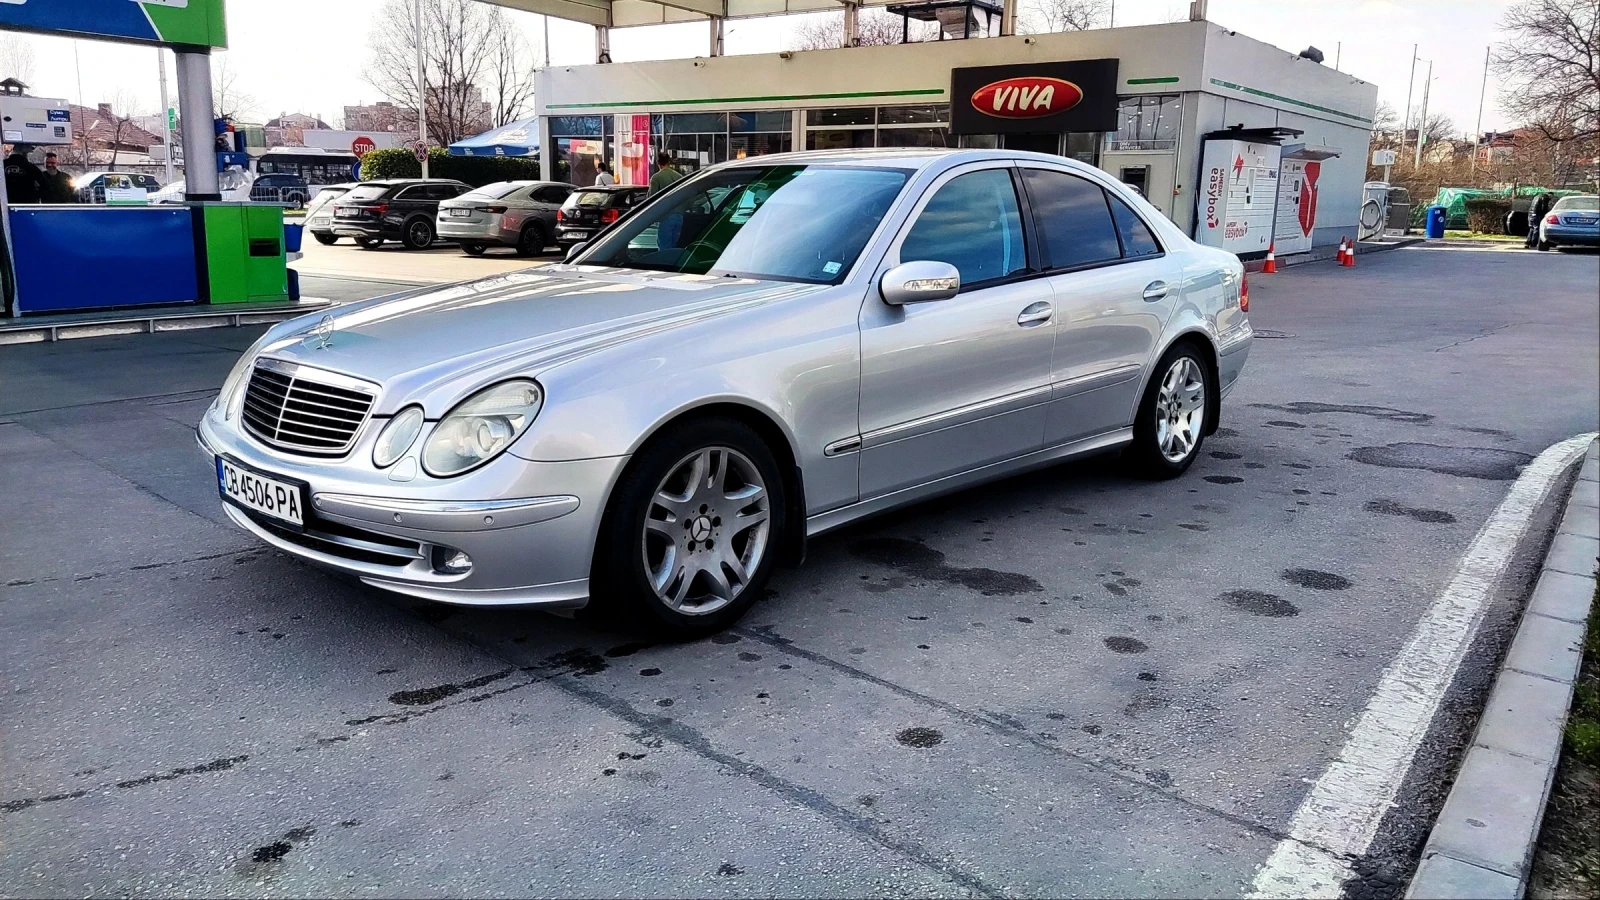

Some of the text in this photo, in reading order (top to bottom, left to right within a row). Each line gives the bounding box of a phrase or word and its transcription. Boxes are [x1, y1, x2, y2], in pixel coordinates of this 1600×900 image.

[993, 85, 1055, 111] VIVA
[354, 143, 375, 153] STOP
[1206, 167, 1220, 221] easybox
